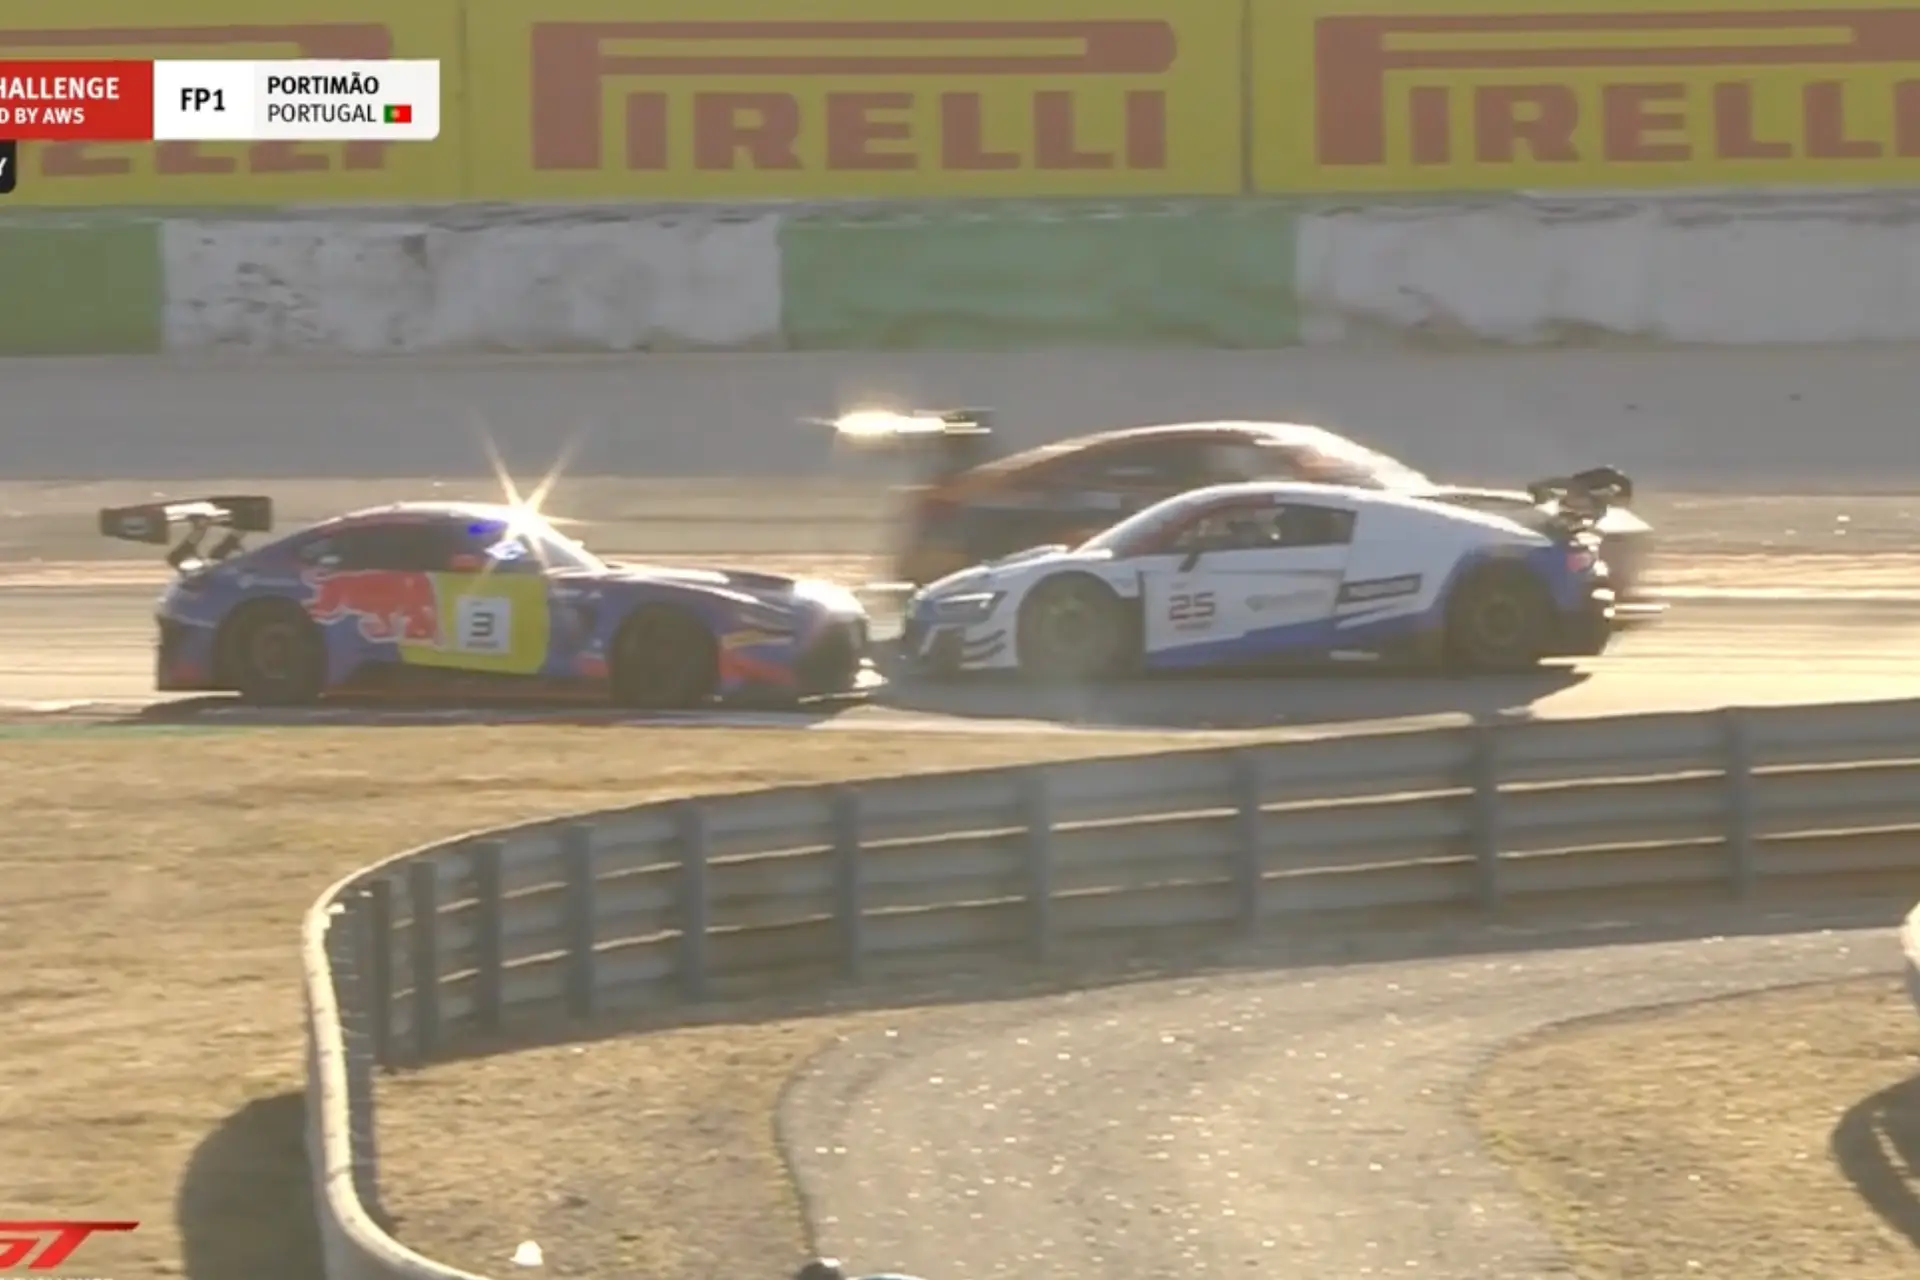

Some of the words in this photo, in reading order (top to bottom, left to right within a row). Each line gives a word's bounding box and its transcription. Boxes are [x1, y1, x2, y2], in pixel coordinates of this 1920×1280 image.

[530, 20, 1177, 170] PIRELLI
[1169, 591, 1216, 621] 25
[471, 611, 495, 637] 3
